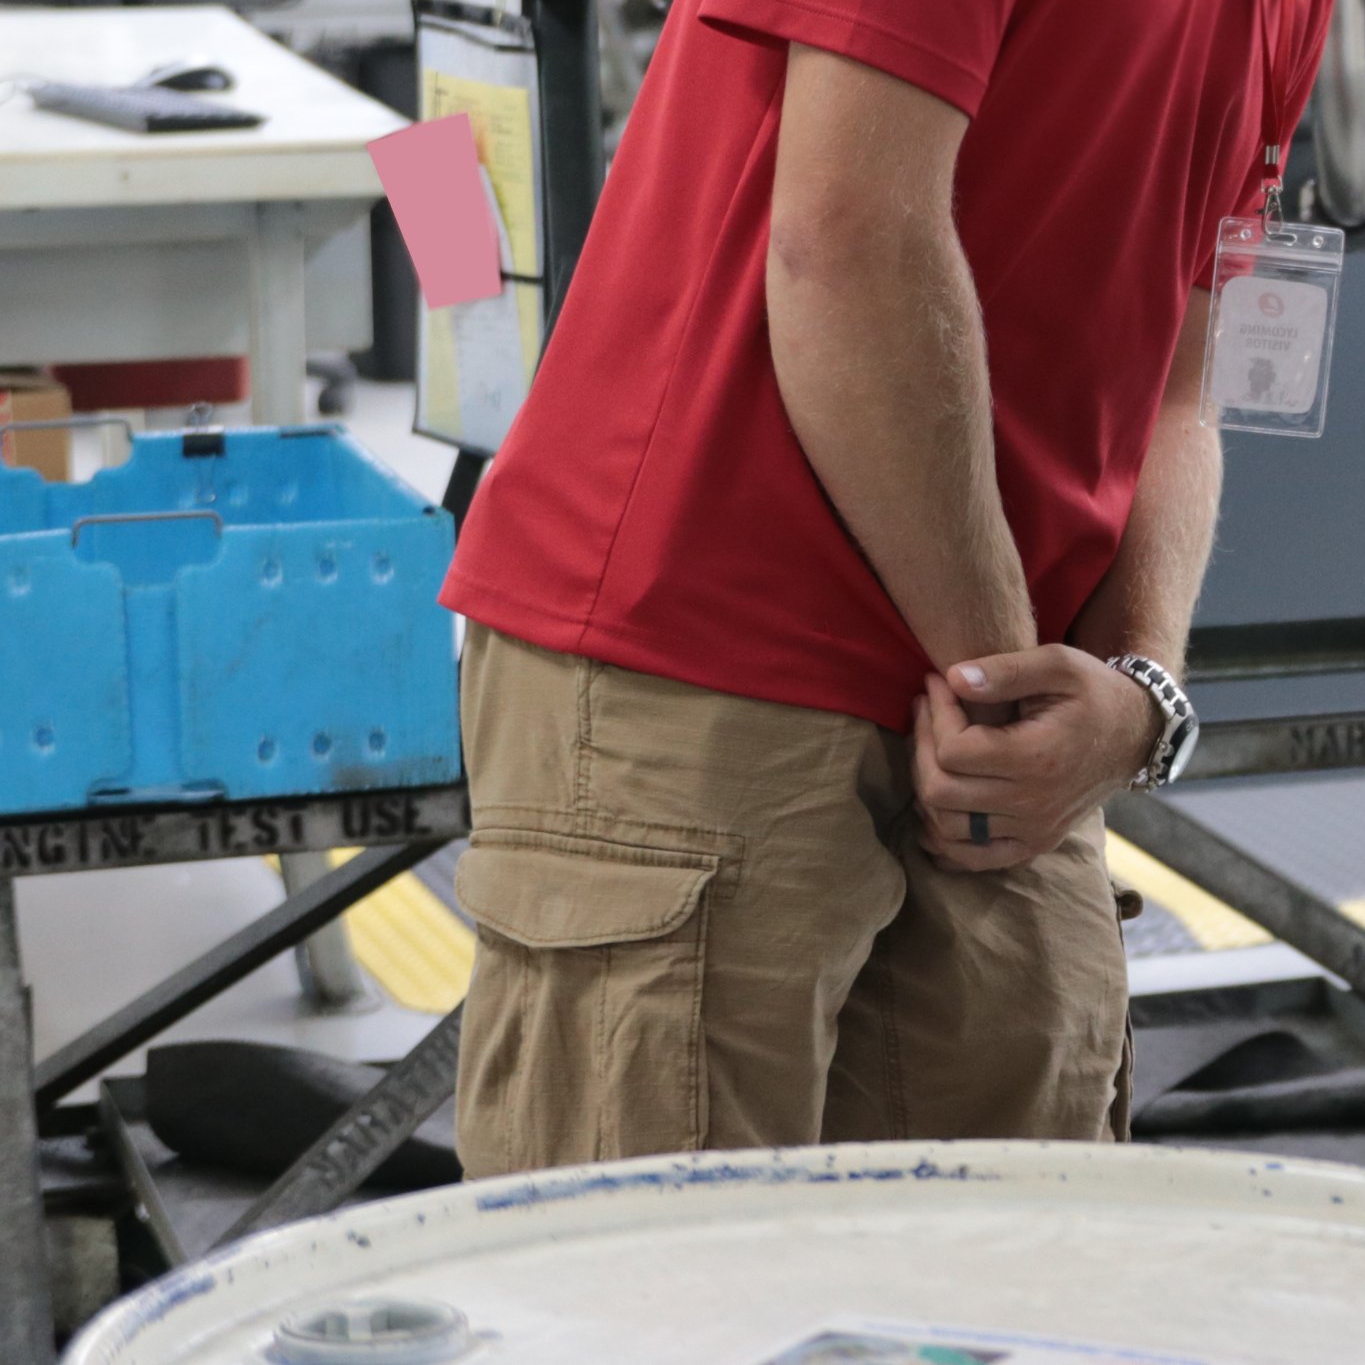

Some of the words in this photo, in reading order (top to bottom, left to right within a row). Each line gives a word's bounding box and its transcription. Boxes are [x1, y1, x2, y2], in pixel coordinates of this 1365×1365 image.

[0, 815, 157, 869] NGINE
[189, 805, 306, 853] TEST
[340, 794, 432, 839] USE
